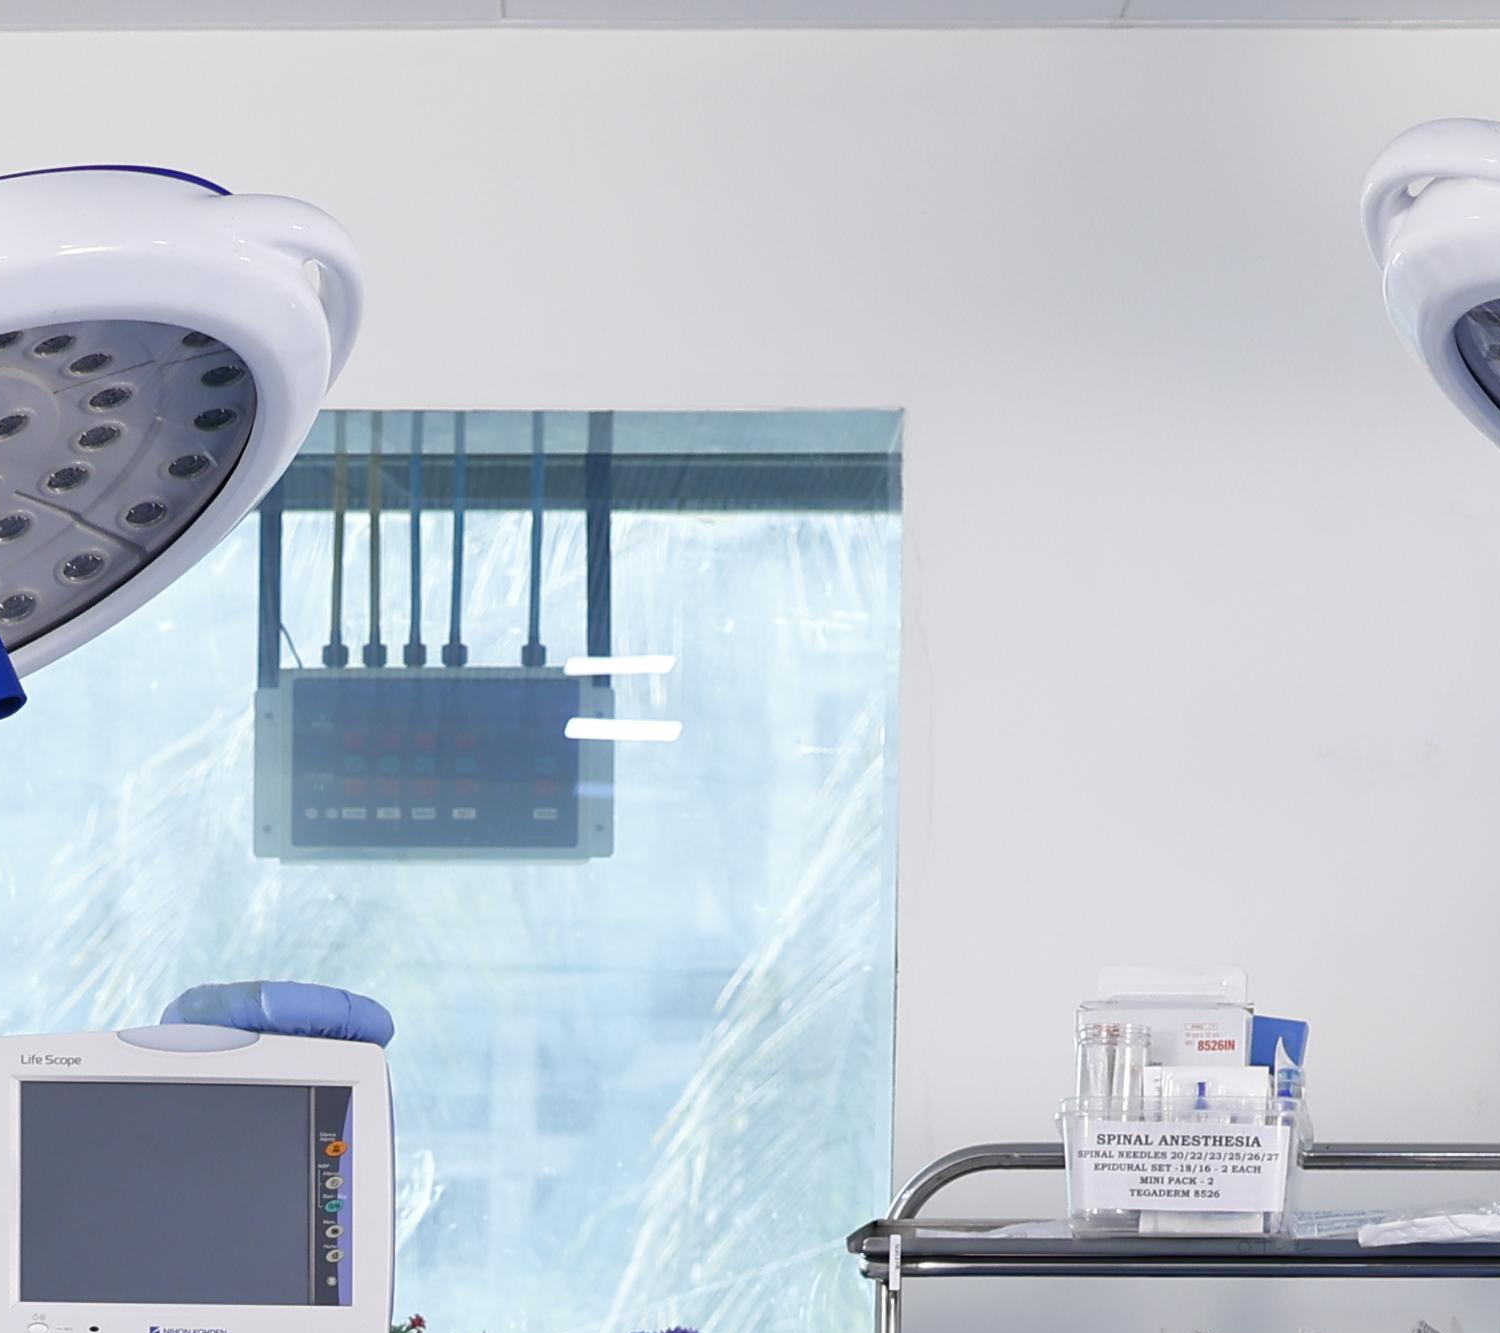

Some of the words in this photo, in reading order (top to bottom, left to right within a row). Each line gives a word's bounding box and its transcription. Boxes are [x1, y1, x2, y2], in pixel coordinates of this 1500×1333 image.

[1197, 1039, 1235, 1051] 8526IN
[20, 1054, 43, 1065] Life
[44, 1054, 82, 1068] Scope
[1097, 1134, 1153, 1145] SPINAL
[1158, 1135, 1261, 1147] ANESTHESIA
[1077, 1150, 1114, 1159] SPINAL
[1118, 1151, 1167, 1160] NEEDLES
[1170, 1152, 1279, 1162] 20/22/23/25/26/27
[1094, 1163, 1147, 1172] EPIDURAL
[1151, 1164, 1171, 1172] SET
[1222, 1165, 1228, 1173] 2
[1231, 1165, 1261, 1173] EACH
[1140, 1177, 1164, 1185] MINI
[1168, 1177, 1197, 1185] PACK
[1130, 1189, 1189, 1198] TEGADERM
[1193, 1190, 1220, 1198] 8526
